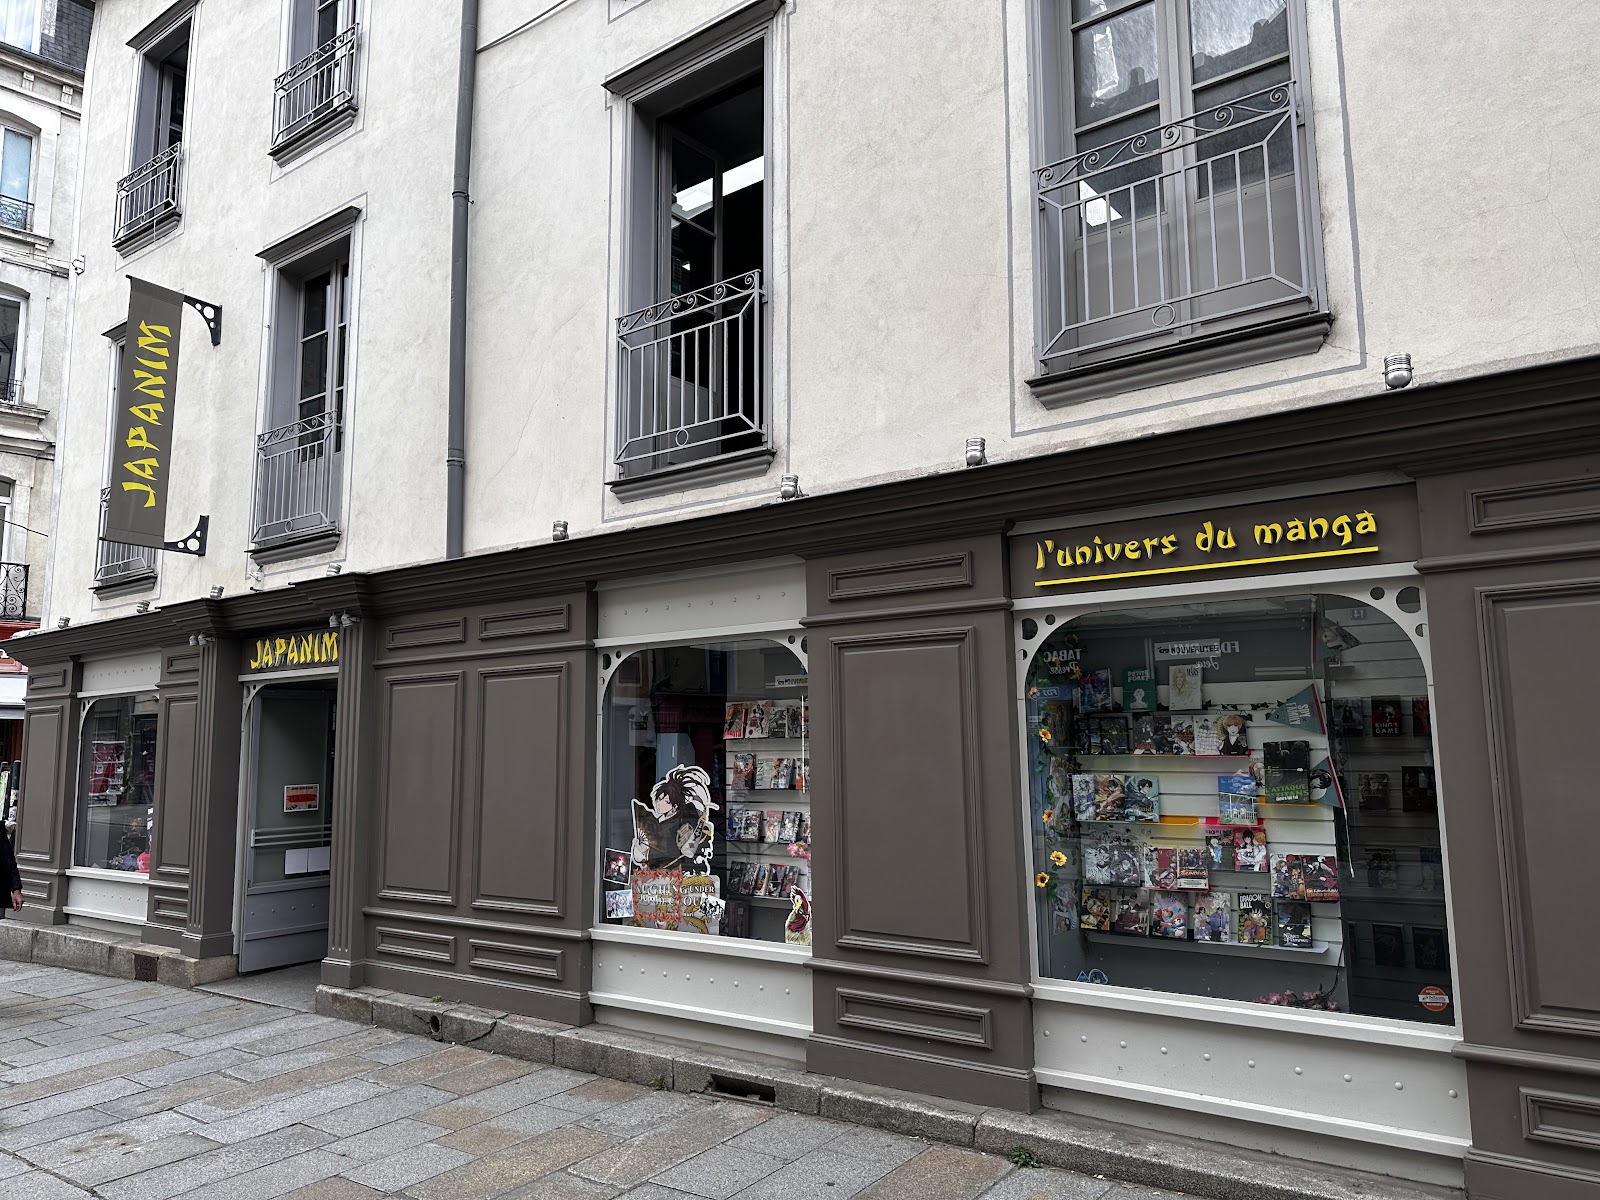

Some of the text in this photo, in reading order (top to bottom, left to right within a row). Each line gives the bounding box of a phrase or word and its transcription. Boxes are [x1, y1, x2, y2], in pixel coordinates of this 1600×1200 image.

[122, 320, 171, 508] JAPANIM
[1035, 509, 1377, 570] l'univers du manga
[250, 631, 338, 669] JAPANIM
[689, 885, 715, 893] UNDER
[1240, 894, 1262, 902] DRAGON
[1240, 901, 1252, 909] BALL
